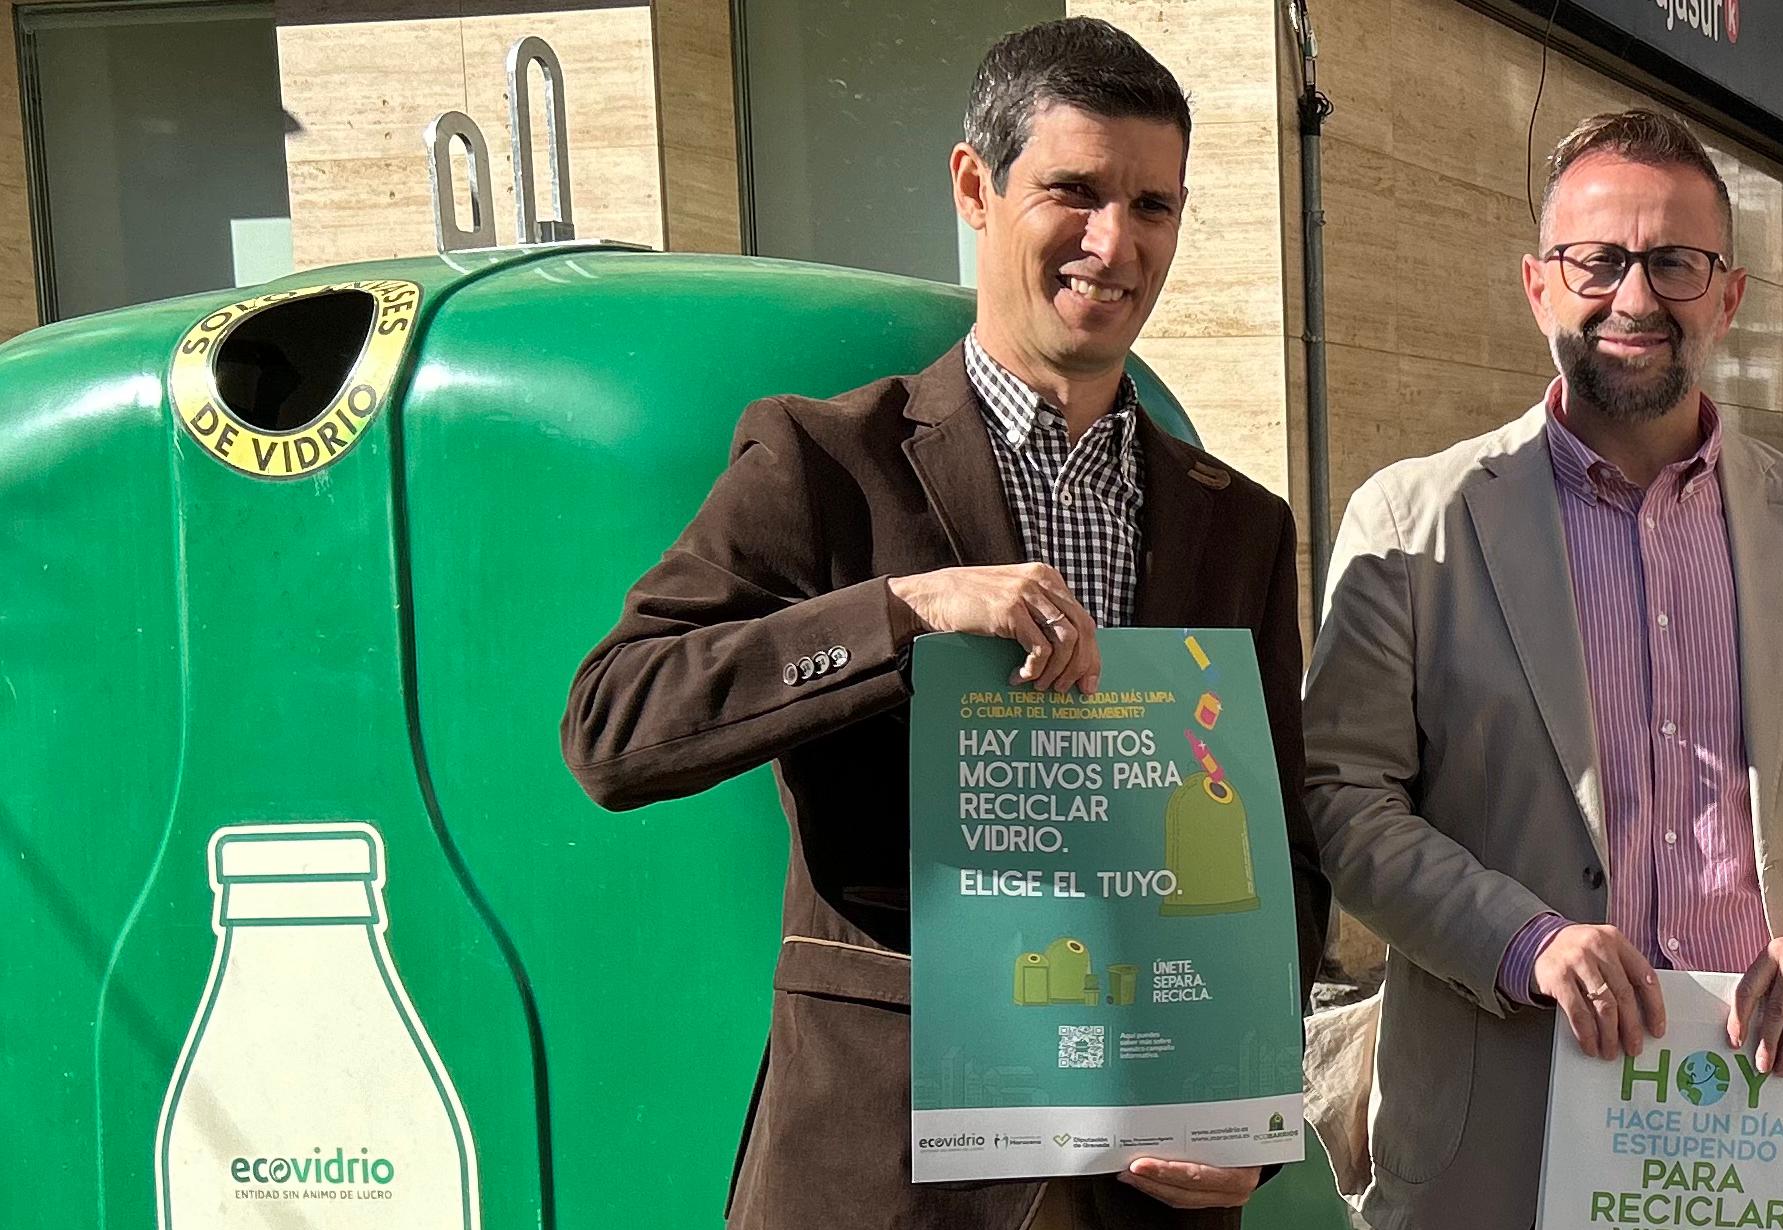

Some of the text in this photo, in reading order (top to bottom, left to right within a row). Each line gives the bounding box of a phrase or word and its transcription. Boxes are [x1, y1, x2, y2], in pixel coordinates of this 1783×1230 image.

[190, 385, 377, 473] DE VIDRIO
[961, 689, 1176, 704] ¿PARA TENER UNA CIUDAD MÁS LIMPIA
[961, 705, 1146, 720] O CUIDAR DEL MEDIOAMBIENTE?
[959, 730, 1156, 758] HAY INFINITOS
[959, 760, 1183, 789] MOTIVOS PARA
[959, 792, 1109, 822] RECICLAR
[961, 825, 1069, 853] VIDRIO.
[960, 869, 1183, 898] ELIGE EL TUYO.
[1621, 1049, 1771, 1109] HOY
[1606, 1107, 1682, 1132] HACE
[1692, 1112, 1731, 1134] UN
[919, 1133, 985, 1149] ecovidrio
[1612, 1133, 1777, 1163] ESTUPENDO
[231, 1147, 394, 1184] ecovidrio
[1642, 1159, 1745, 1194] PARA
[235, 1188, 392, 1200] ENTIDAD SIN ÁNIMO DE LUCRO
